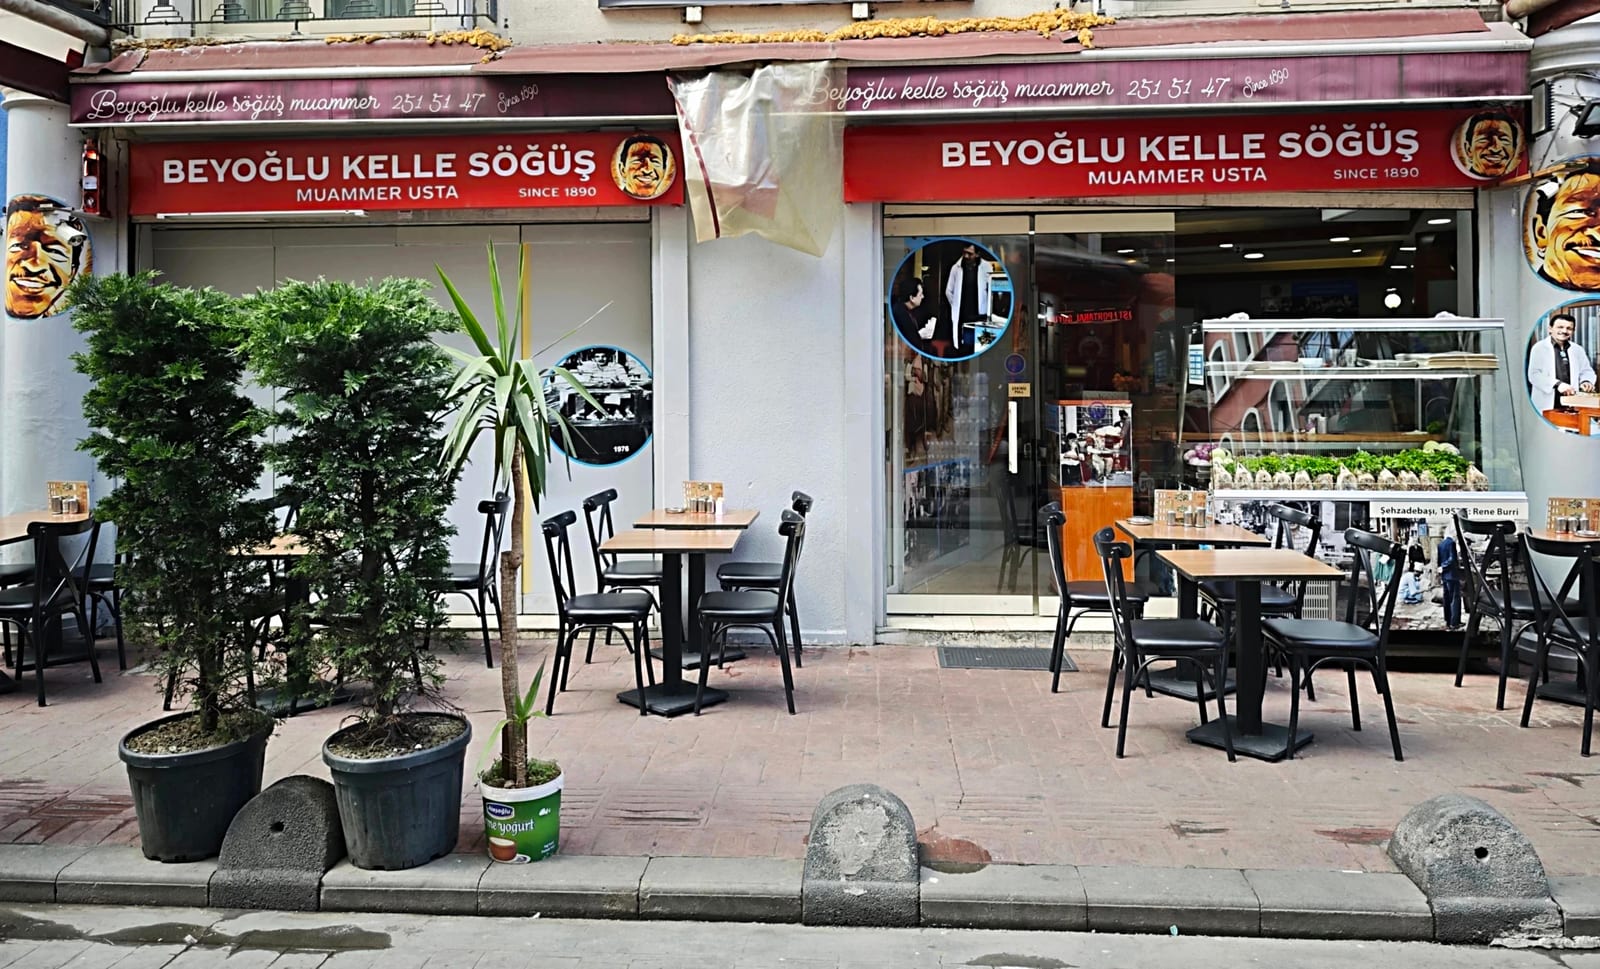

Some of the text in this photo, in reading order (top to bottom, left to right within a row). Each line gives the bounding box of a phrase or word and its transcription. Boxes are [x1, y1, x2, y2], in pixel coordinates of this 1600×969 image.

[796, 71, 1231, 110] Beyoğlu kelle söğüş muammer 251 51 47
[1242, 67, 1289, 98] Since 1890
[87, 89, 487, 121] Beyoğlu kelle söğüş muammer 251 51 47
[497, 83, 539, 113] Since 1890
[942, 122, 1420, 167] BEYOĞLU KELLE SÖĞÜŞ
[163, 144, 597, 184] BEYOĞLU KELLE SÖĞÜŞ
[1088, 167, 1267, 185] MUAMMER USTA
[1333, 167, 1420, 179] SINCE 1890
[296, 185, 459, 202] MUAMMER USTA
[518, 186, 597, 198] SINCE 1890
[1380, 506, 1438, 516] Şehzadebaşı,
[1473, 508, 1495, 516] Rene
[1497, 507, 1519, 516] Burri
